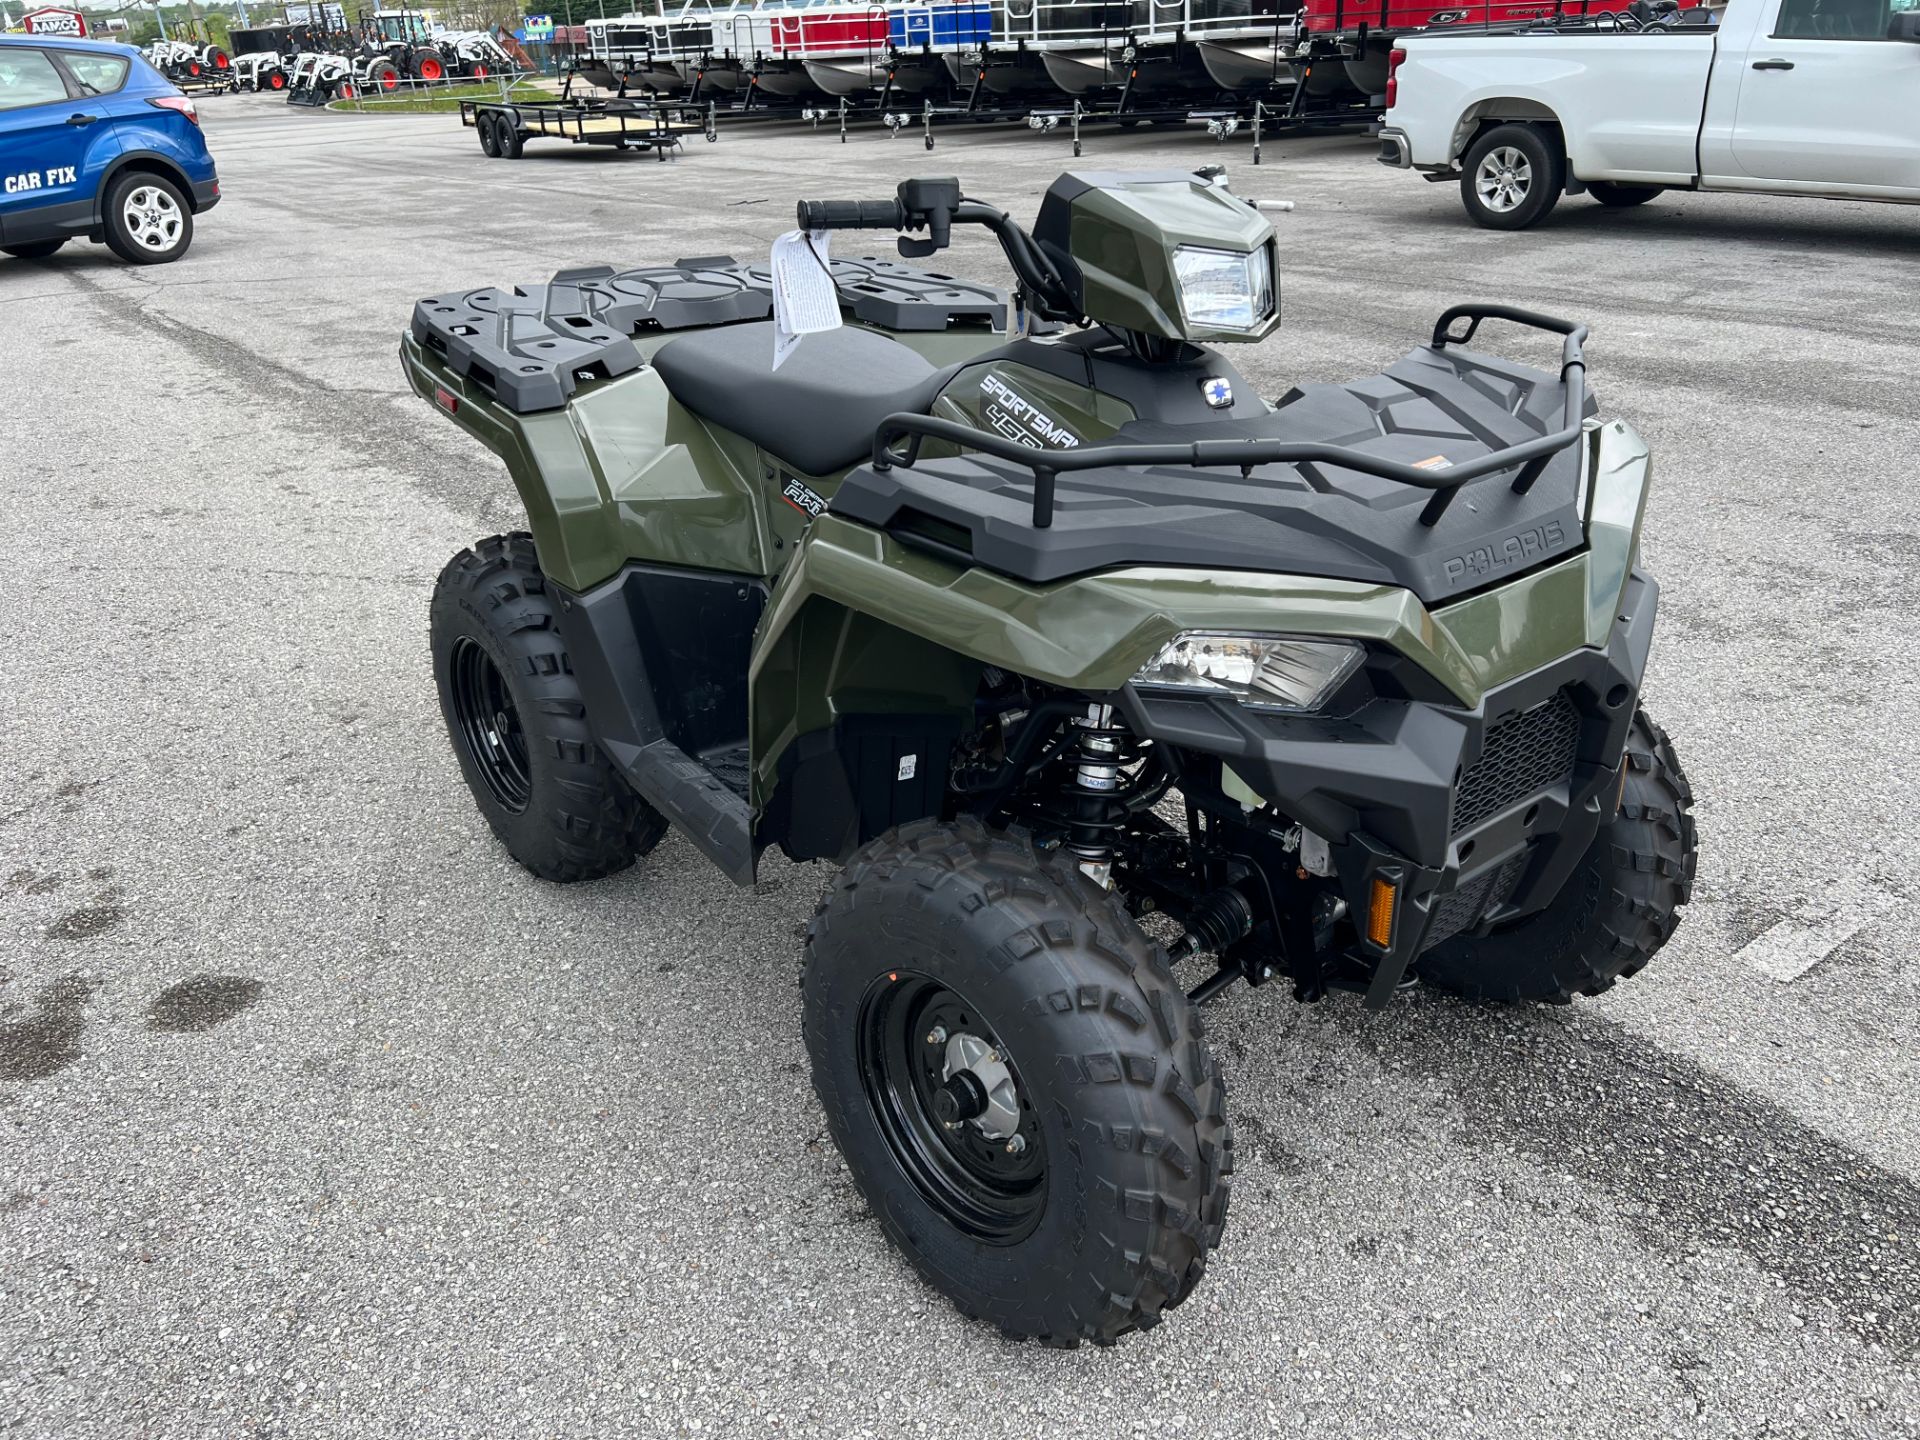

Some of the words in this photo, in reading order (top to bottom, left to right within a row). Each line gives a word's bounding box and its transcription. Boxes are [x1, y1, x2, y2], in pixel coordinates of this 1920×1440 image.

[32, 20, 80, 33] AAMCO
[5, 172, 42, 193] CAR
[46, 166, 77, 186] FIX
[1443, 520, 1565, 584] POLARIS
[1085, 777, 1107, 788] SACHS
